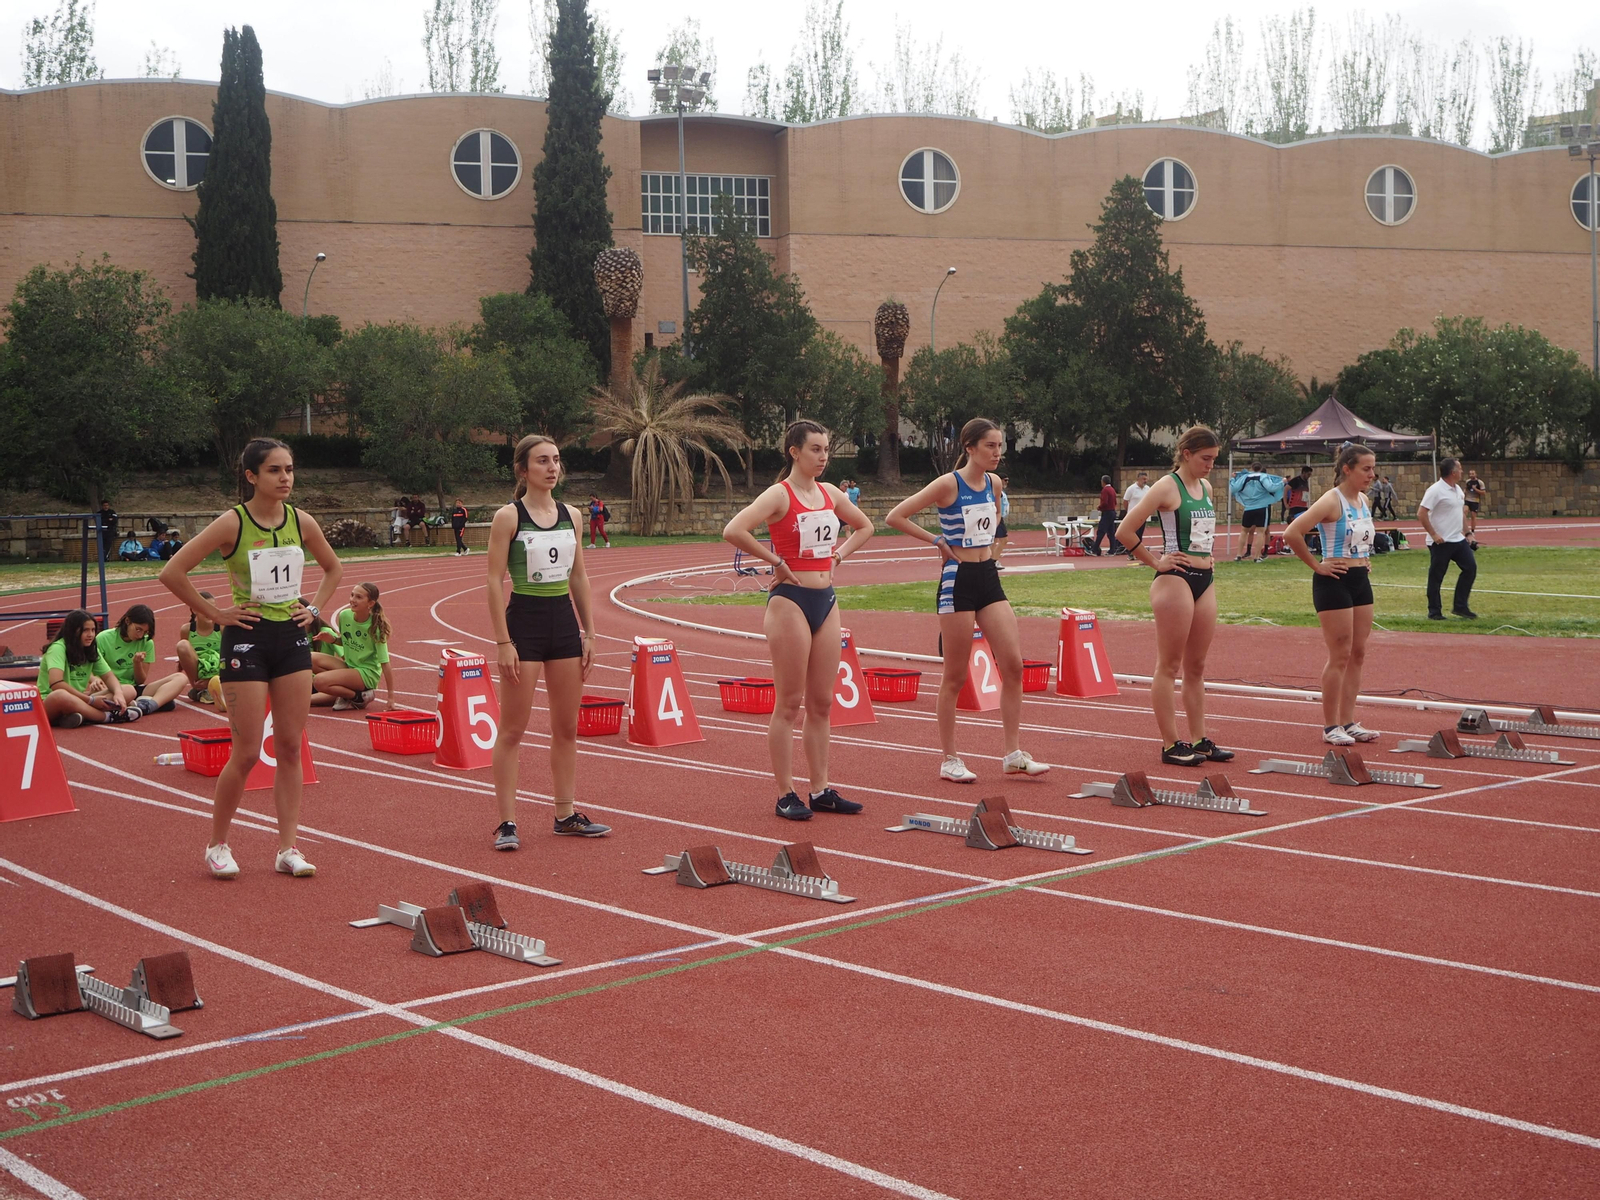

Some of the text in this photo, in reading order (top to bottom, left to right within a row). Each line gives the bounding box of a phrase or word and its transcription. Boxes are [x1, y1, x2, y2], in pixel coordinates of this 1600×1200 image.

[977, 517, 990, 531] 10
[814, 525, 832, 542] 12
[1362, 530, 1370, 541] 8
[548, 547, 559, 564] 9
[270, 564, 290, 583] 11
[647, 643, 674, 653] MONDO
[456, 658, 486, 667] MONDO
[652, 654, 671, 663] Joma
[1083, 642, 1102, 683] 1
[462, 668, 482, 678] Joma
[974, 649, 997, 694] 2
[835, 661, 860, 709] 3
[0, 690, 38, 701] MONDO
[658, 677, 684, 727] 4
[3, 702, 30, 713] Joma
[467, 695, 498, 750] 5
[5, 724, 40, 790] 7
[909, 819, 931, 827] MONDO
